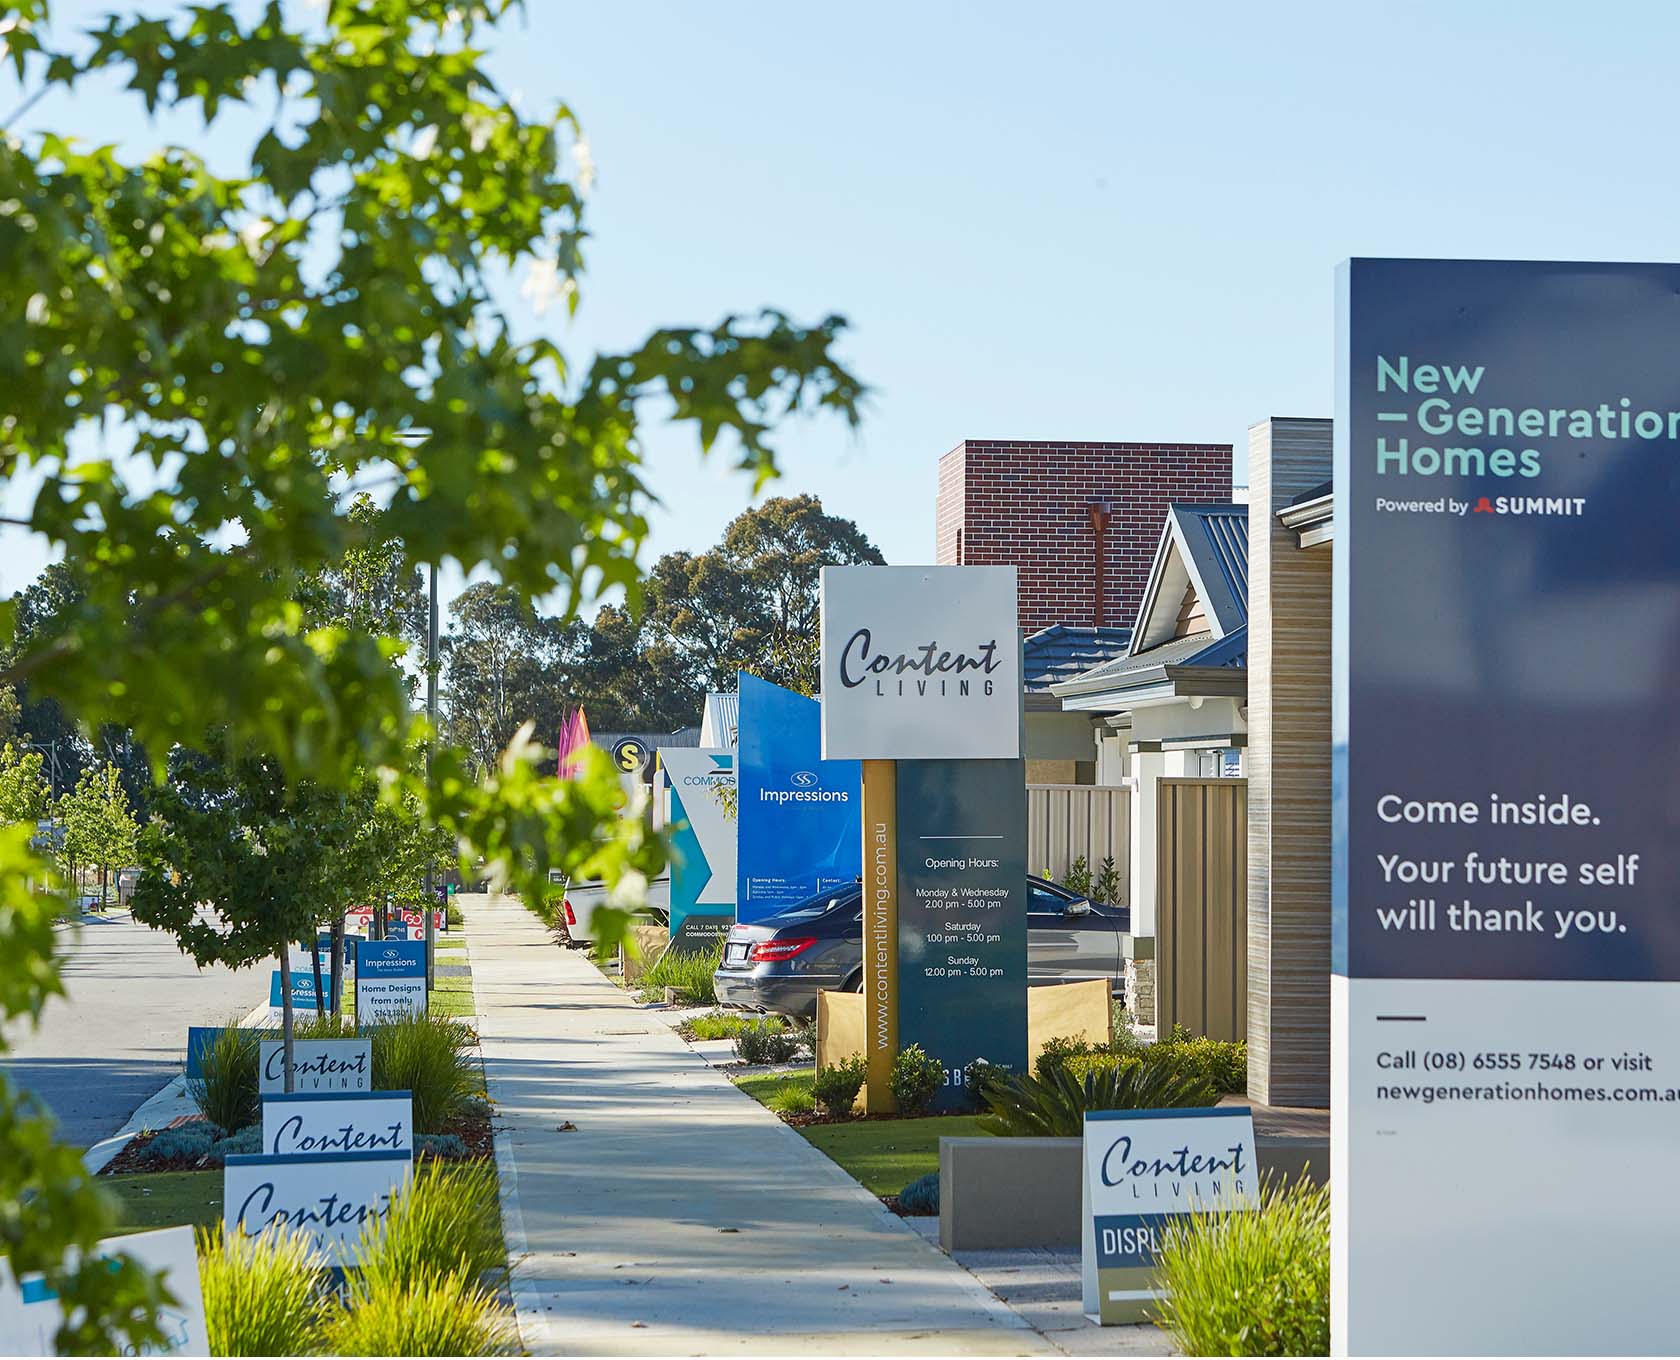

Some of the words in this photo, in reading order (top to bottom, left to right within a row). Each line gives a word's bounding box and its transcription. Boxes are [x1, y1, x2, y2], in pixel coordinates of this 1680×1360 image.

[1377, 355, 1485, 394] New
[1377, 438, 1541, 477] Homes
[1376, 498, 1444, 513] Powered
[1449, 498, 1468, 516] by
[1495, 497, 1586, 515] SUMMIT
[840, 628, 1002, 688] Content
[877, 680, 993, 697] LIVING
[621, 744, 639, 770] S
[684, 776, 736, 785] COMMOD
[760, 788, 848, 805] Impressions
[1377, 795, 1479, 823] Come
[1491, 794, 1600, 825] inside.
[925, 858, 965, 870] Opening
[968, 858, 999, 868] Hours:
[1377, 854, 1454, 883] Your
[1464, 852, 1568, 884] future
[1579, 854, 1639, 885] self
[916, 888, 949, 899] Monday
[951, 888, 958, 897] &
[961, 888, 1009, 898] Wednesday
[925, 900, 943, 908] 2.00
[945, 901, 959, 910] pm
[987, 901, 1001, 910] pm
[945, 922, 981, 932] Saturday
[1377, 899, 1436, 930] will
[1447, 900, 1544, 932] thank
[1554, 911, 1626, 939] you.
[873, 823, 890, 1050] www.contentliving.com.au
[945, 935, 958, 944] pm
[987, 934, 1000, 943] pm
[366, 958, 416, 968] Impressions
[948, 956, 979, 966] Sunday
[947, 969, 961, 978] pm
[989, 969, 1003, 977] pm
[389, 984, 421, 993] Designs
[394, 997, 412, 1005] only
[1377, 1052, 1416, 1070] Call
[1423, 1052, 1465, 1071] (08)
[1473, 1053, 1521, 1070] 6555
[1528, 1053, 1576, 1071] 7548
[1583, 1058, 1604, 1071] or
[1611, 1053, 1652, 1071] visit
[301, 1077, 363, 1089] IVING
[1377, 1083, 1680, 1104] newgenerationhomes.com.a
[274, 1115, 403, 1154] Content
[1101, 1136, 1245, 1187] Content
[1132, 1180, 1244, 1198] LIVING
